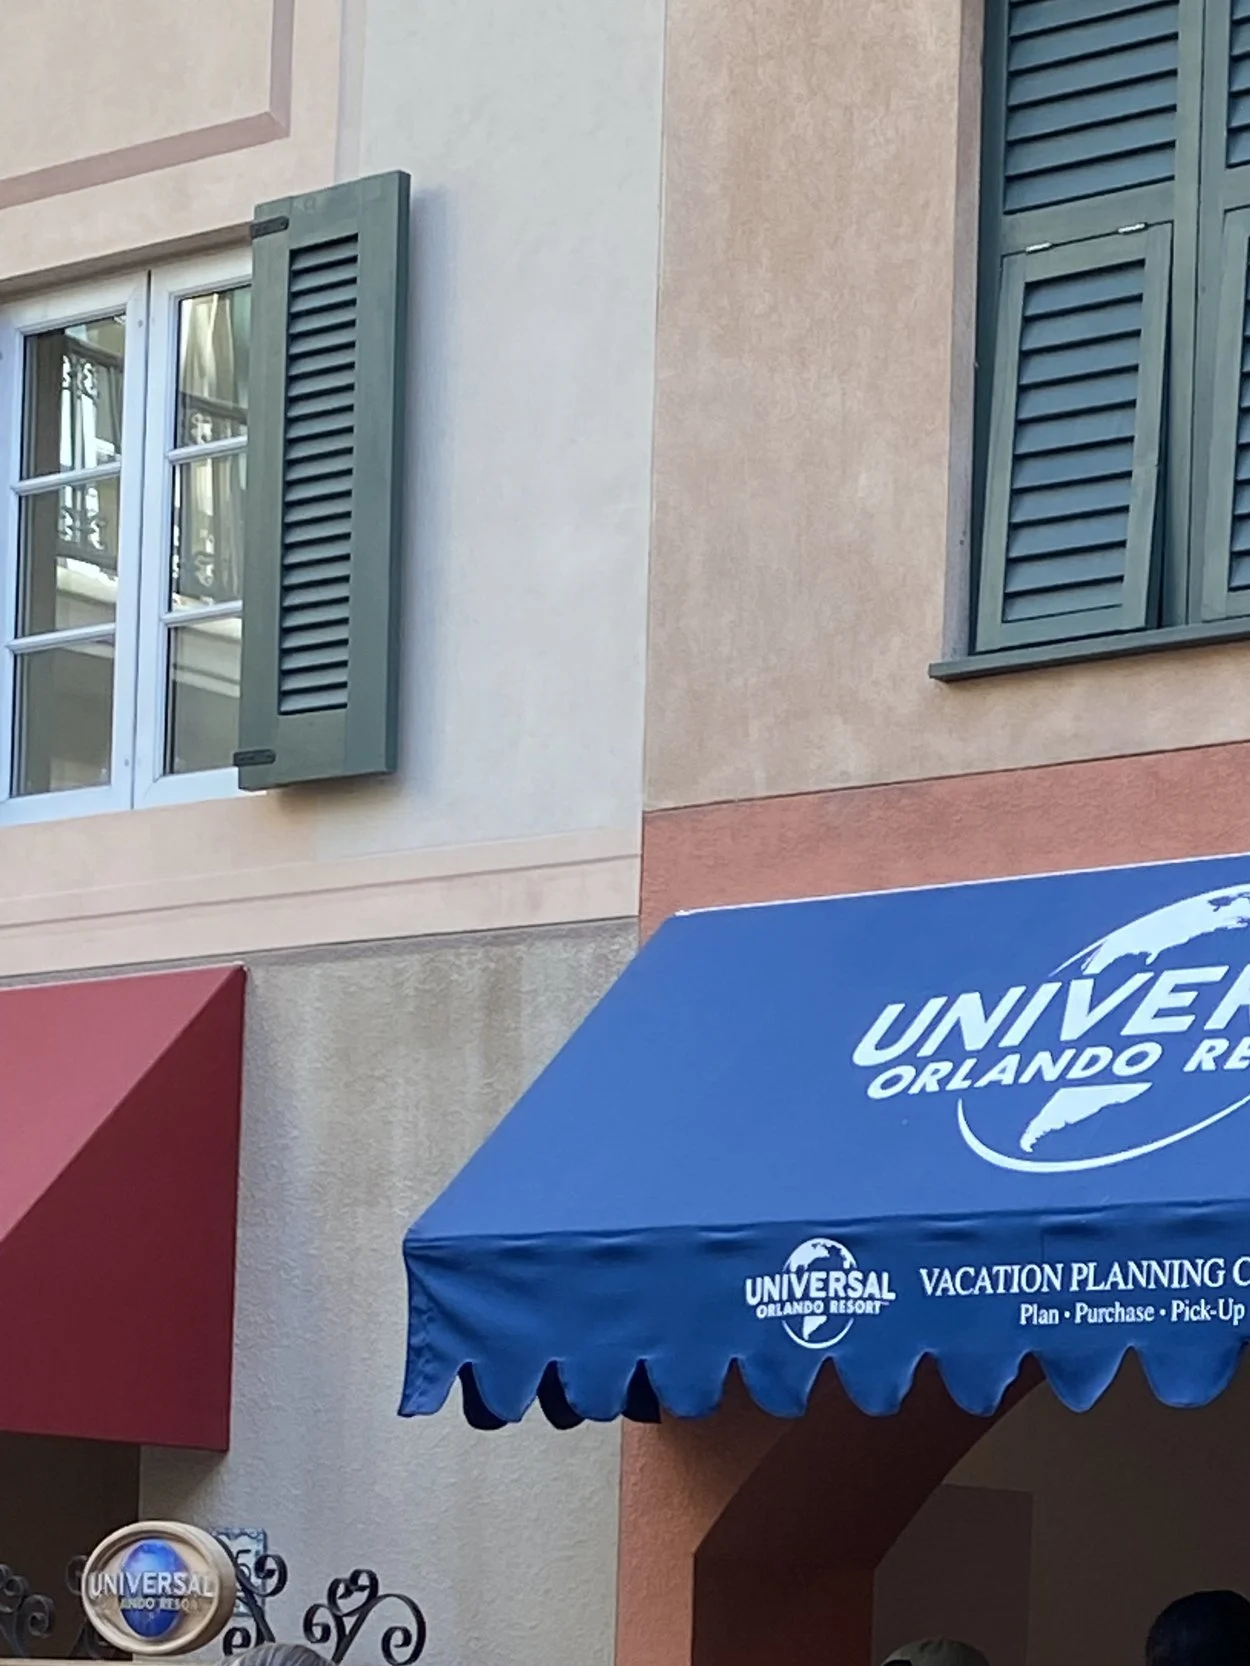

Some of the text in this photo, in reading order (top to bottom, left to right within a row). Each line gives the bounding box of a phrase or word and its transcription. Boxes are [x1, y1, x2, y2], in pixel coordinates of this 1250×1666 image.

[866, 1038, 1163, 1100] ORLANDO
[745, 1270, 897, 1306] UNIVERSAL
[919, 1263, 1064, 1297] VACATION
[1069, 1257, 1226, 1292] PLANNING
[756, 1300, 881, 1319] ORLANDO RESORT
[1020, 1297, 1246, 1326] Plan Purchase Pick-Up
[88, 1571, 214, 1598] UNIVERSAL
